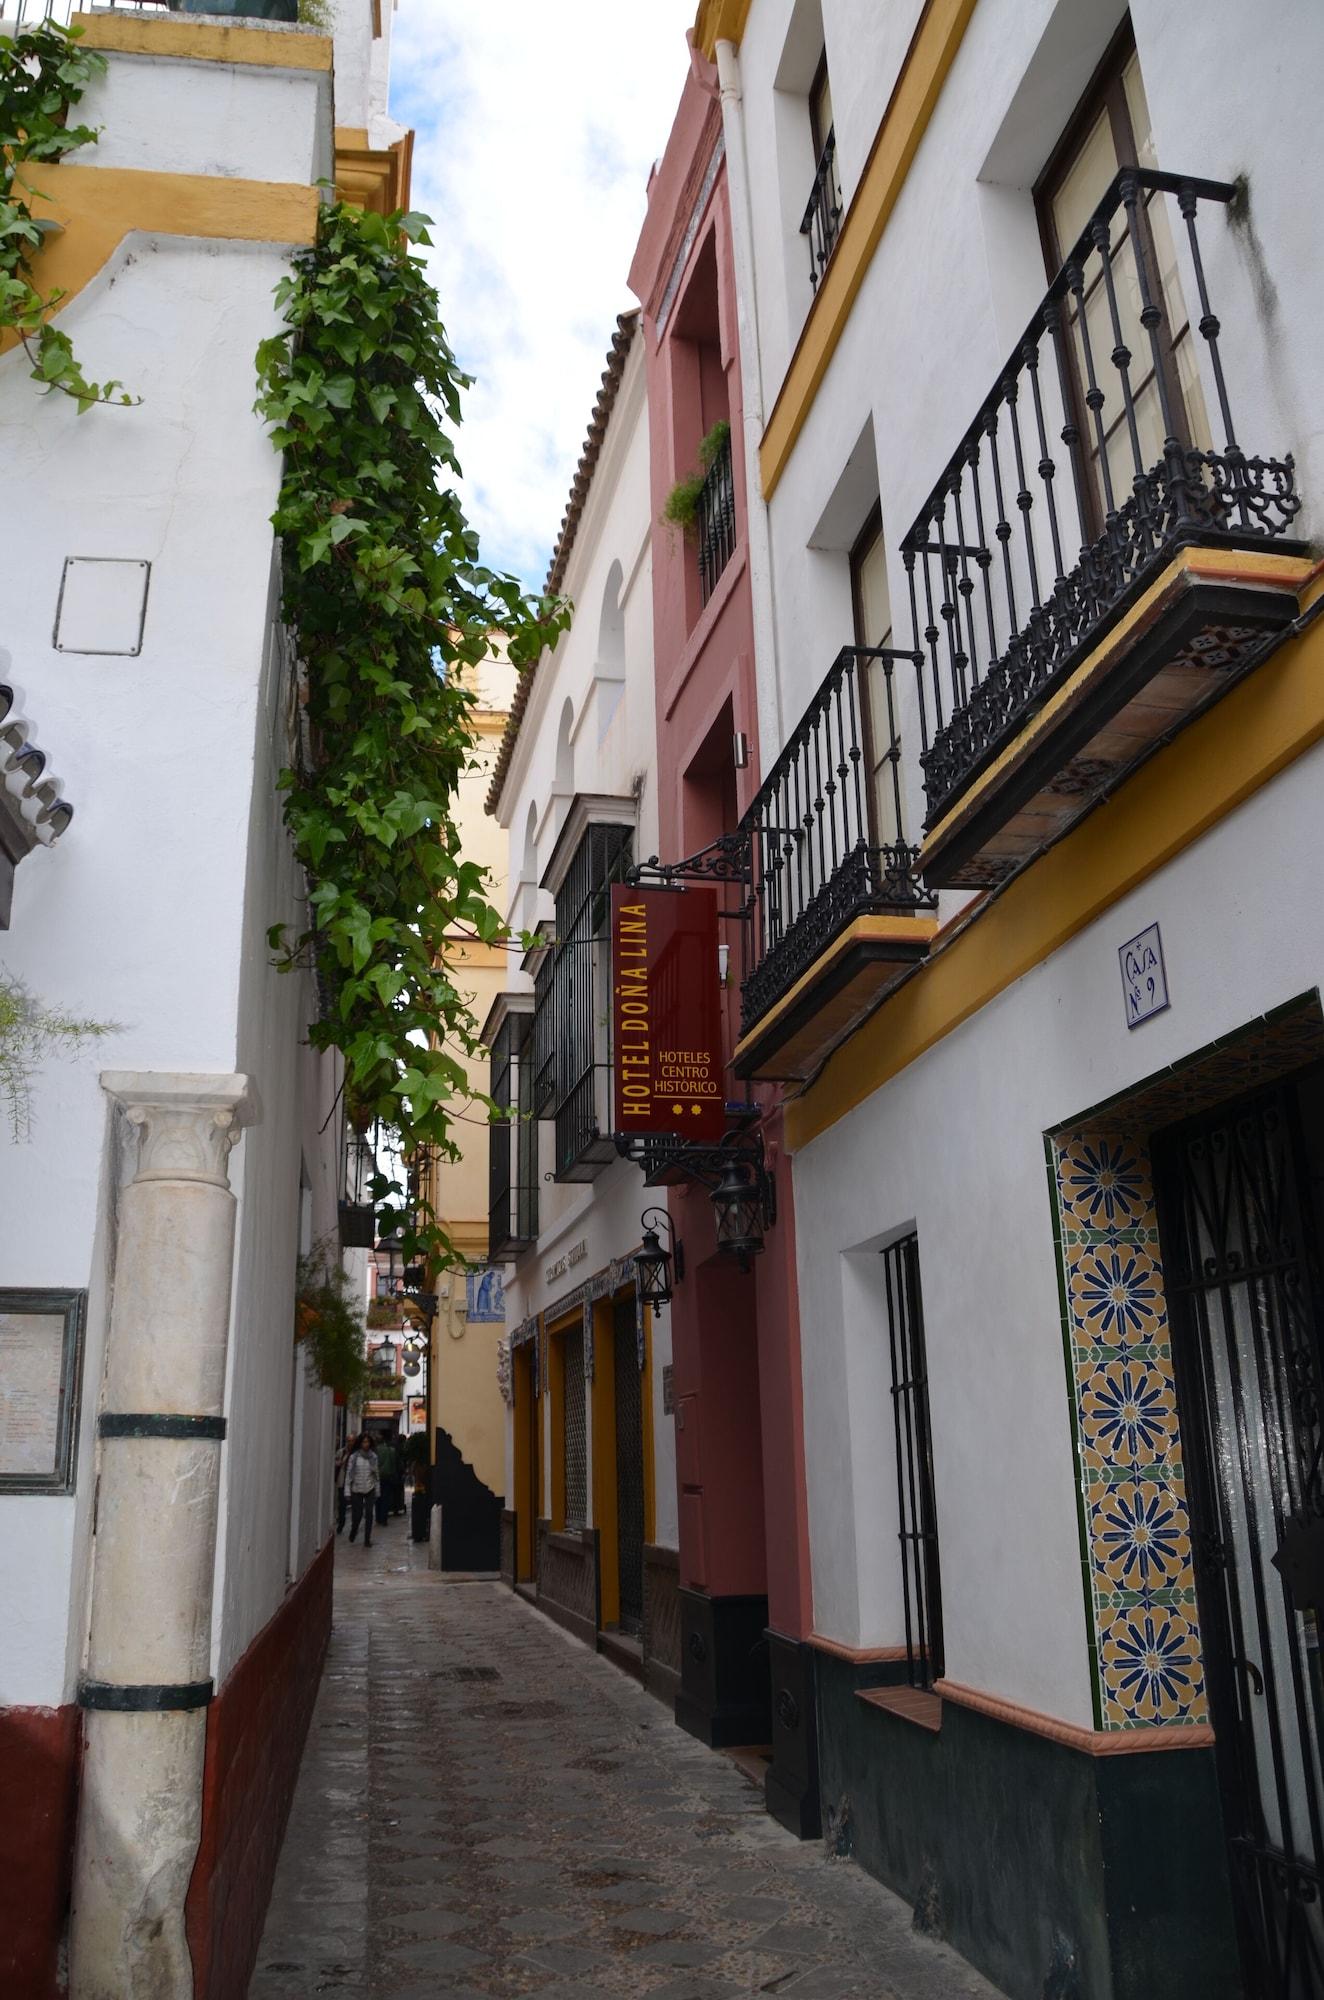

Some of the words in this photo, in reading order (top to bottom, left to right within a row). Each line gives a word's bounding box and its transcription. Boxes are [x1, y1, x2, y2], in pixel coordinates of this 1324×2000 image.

[619, 904, 647, 957] LINA
[1125, 946, 1158, 986] CASA
[616, 967, 649, 1031] DOÑA
[1146, 977, 1155, 1007] 9
[659, 1051, 711, 1064] HOTELES
[661, 1065, 709, 1079] CENTRO
[622, 1041, 650, 1115] HOTEL
[654, 1079, 717, 1094] HISTÓRICO
